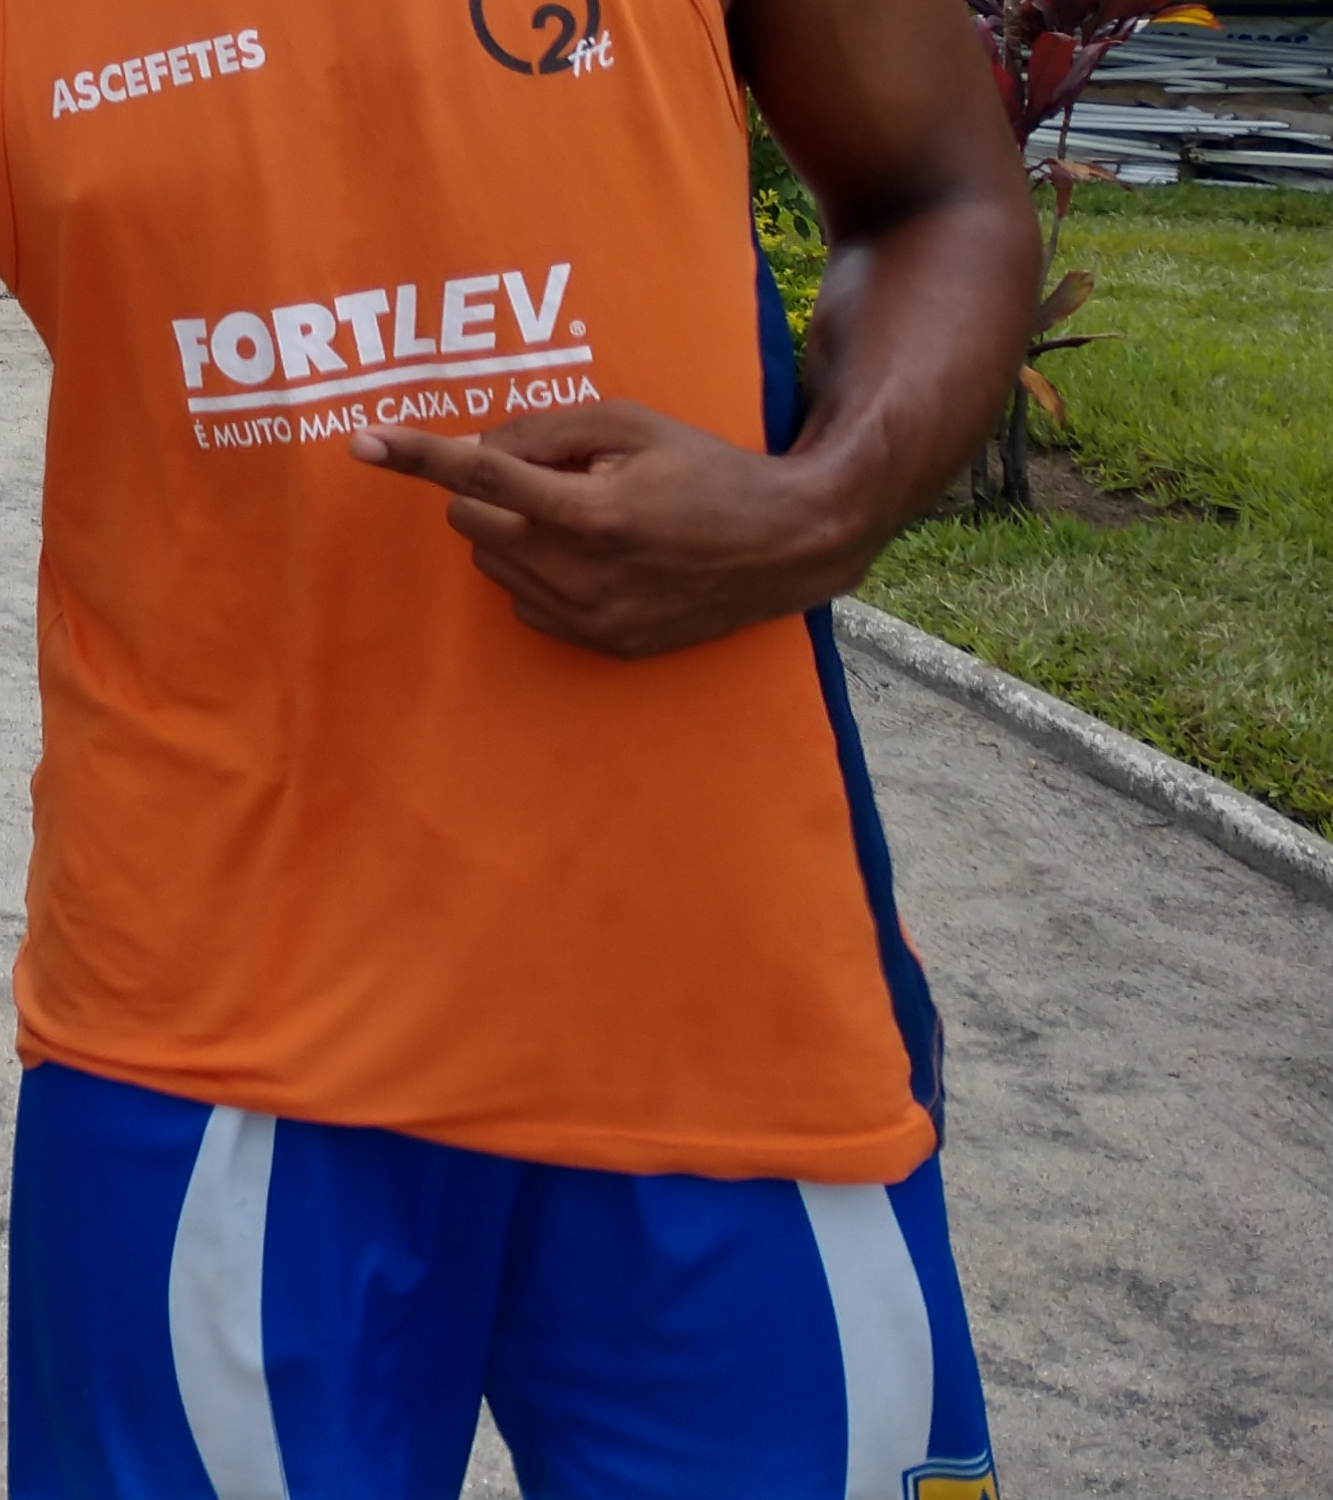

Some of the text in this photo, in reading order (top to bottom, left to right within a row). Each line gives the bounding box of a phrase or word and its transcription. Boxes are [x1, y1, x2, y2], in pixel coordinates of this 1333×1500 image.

[51, 28, 266, 119] ASCEFETES
[567, 30, 614, 78] fit
[192, 418, 211, 450] É
[213, 416, 292, 449] MUITO
[299, 403, 369, 444] MAIS
[375, 390, 459, 426] CAIXA
[505, 375, 601, 414] ÁGUA
